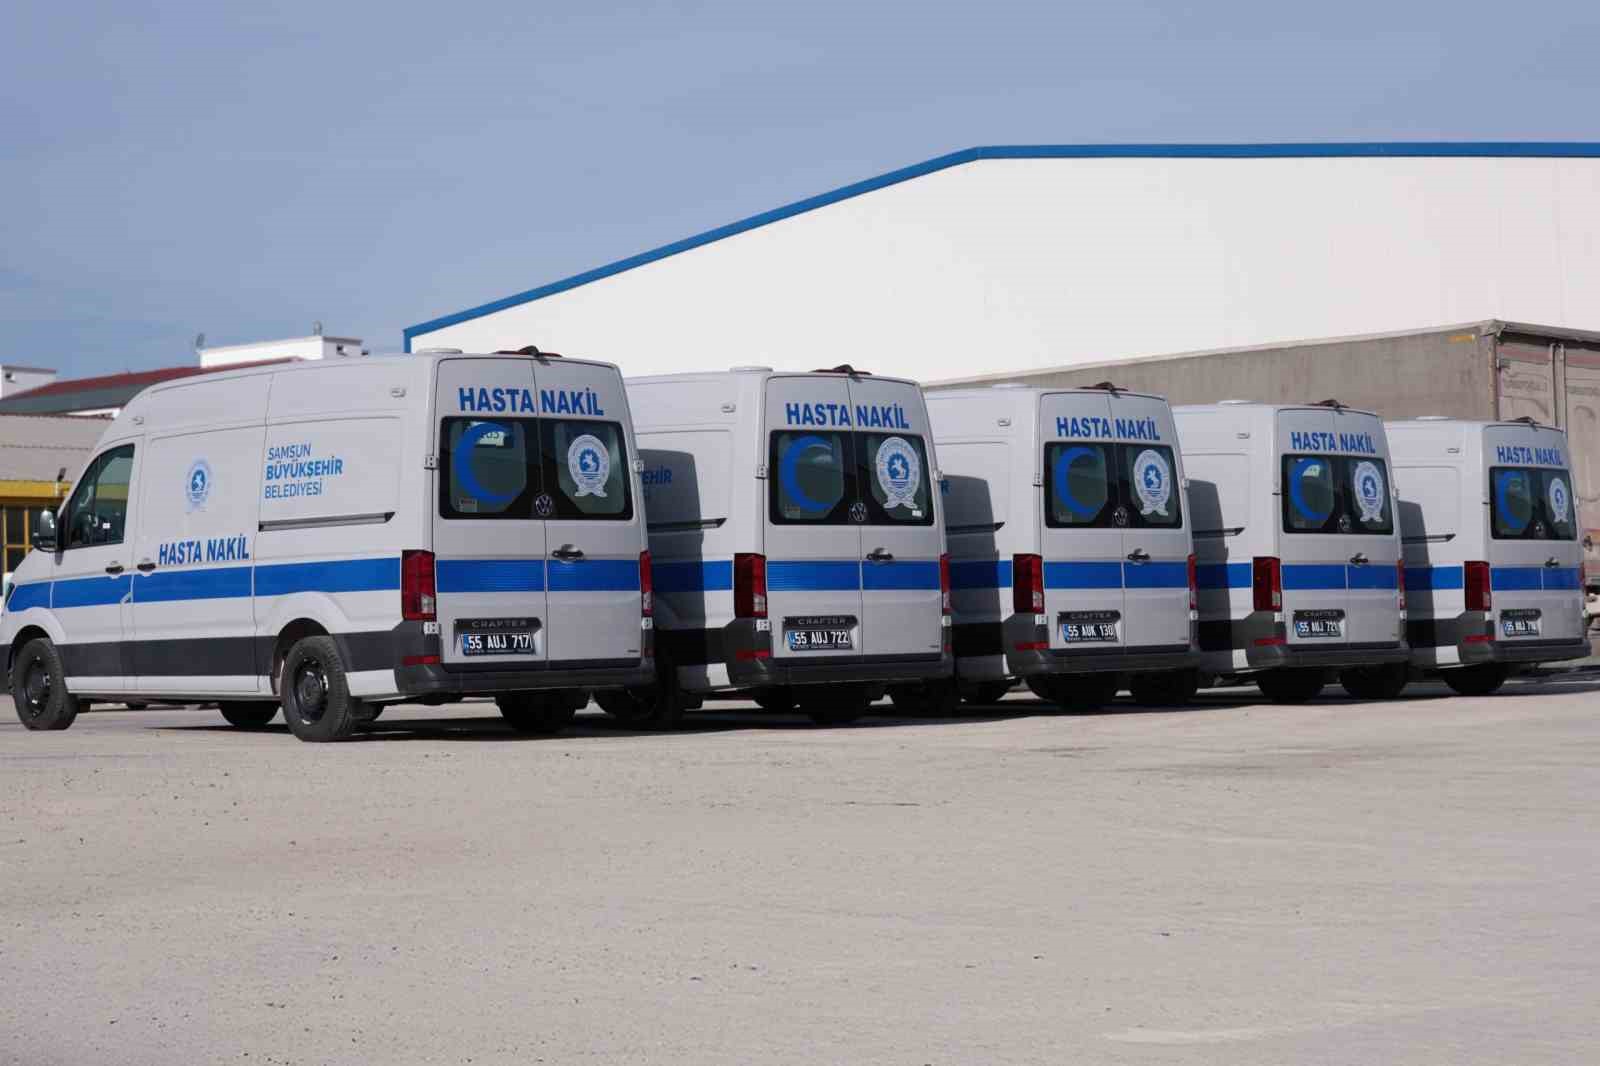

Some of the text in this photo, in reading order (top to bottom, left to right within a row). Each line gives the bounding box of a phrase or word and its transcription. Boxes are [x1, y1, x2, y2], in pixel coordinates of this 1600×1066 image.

[458, 387, 604, 416] HASTA NAKİL
[786, 403, 910, 429] HASTA NAKİL
[1056, 416, 1160, 441] HASTA NAKİL
[267, 443, 312, 461] SAMSUN
[1291, 432, 1376, 454] HASTA NAKİL
[1496, 446, 1533, 464] HASTA
[265, 455, 343, 480] BÜYÜKŞEHİR
[264, 479, 322, 499] BELEDİYESİ
[159, 533, 249, 565] HASTA NAKİL
[1068, 625, 1079, 637] 55
[1299, 622, 1310, 632] 55
[468, 634, 530, 649] 55 AUJ 717
[794, 631, 849, 645] 55 AUJ 722
